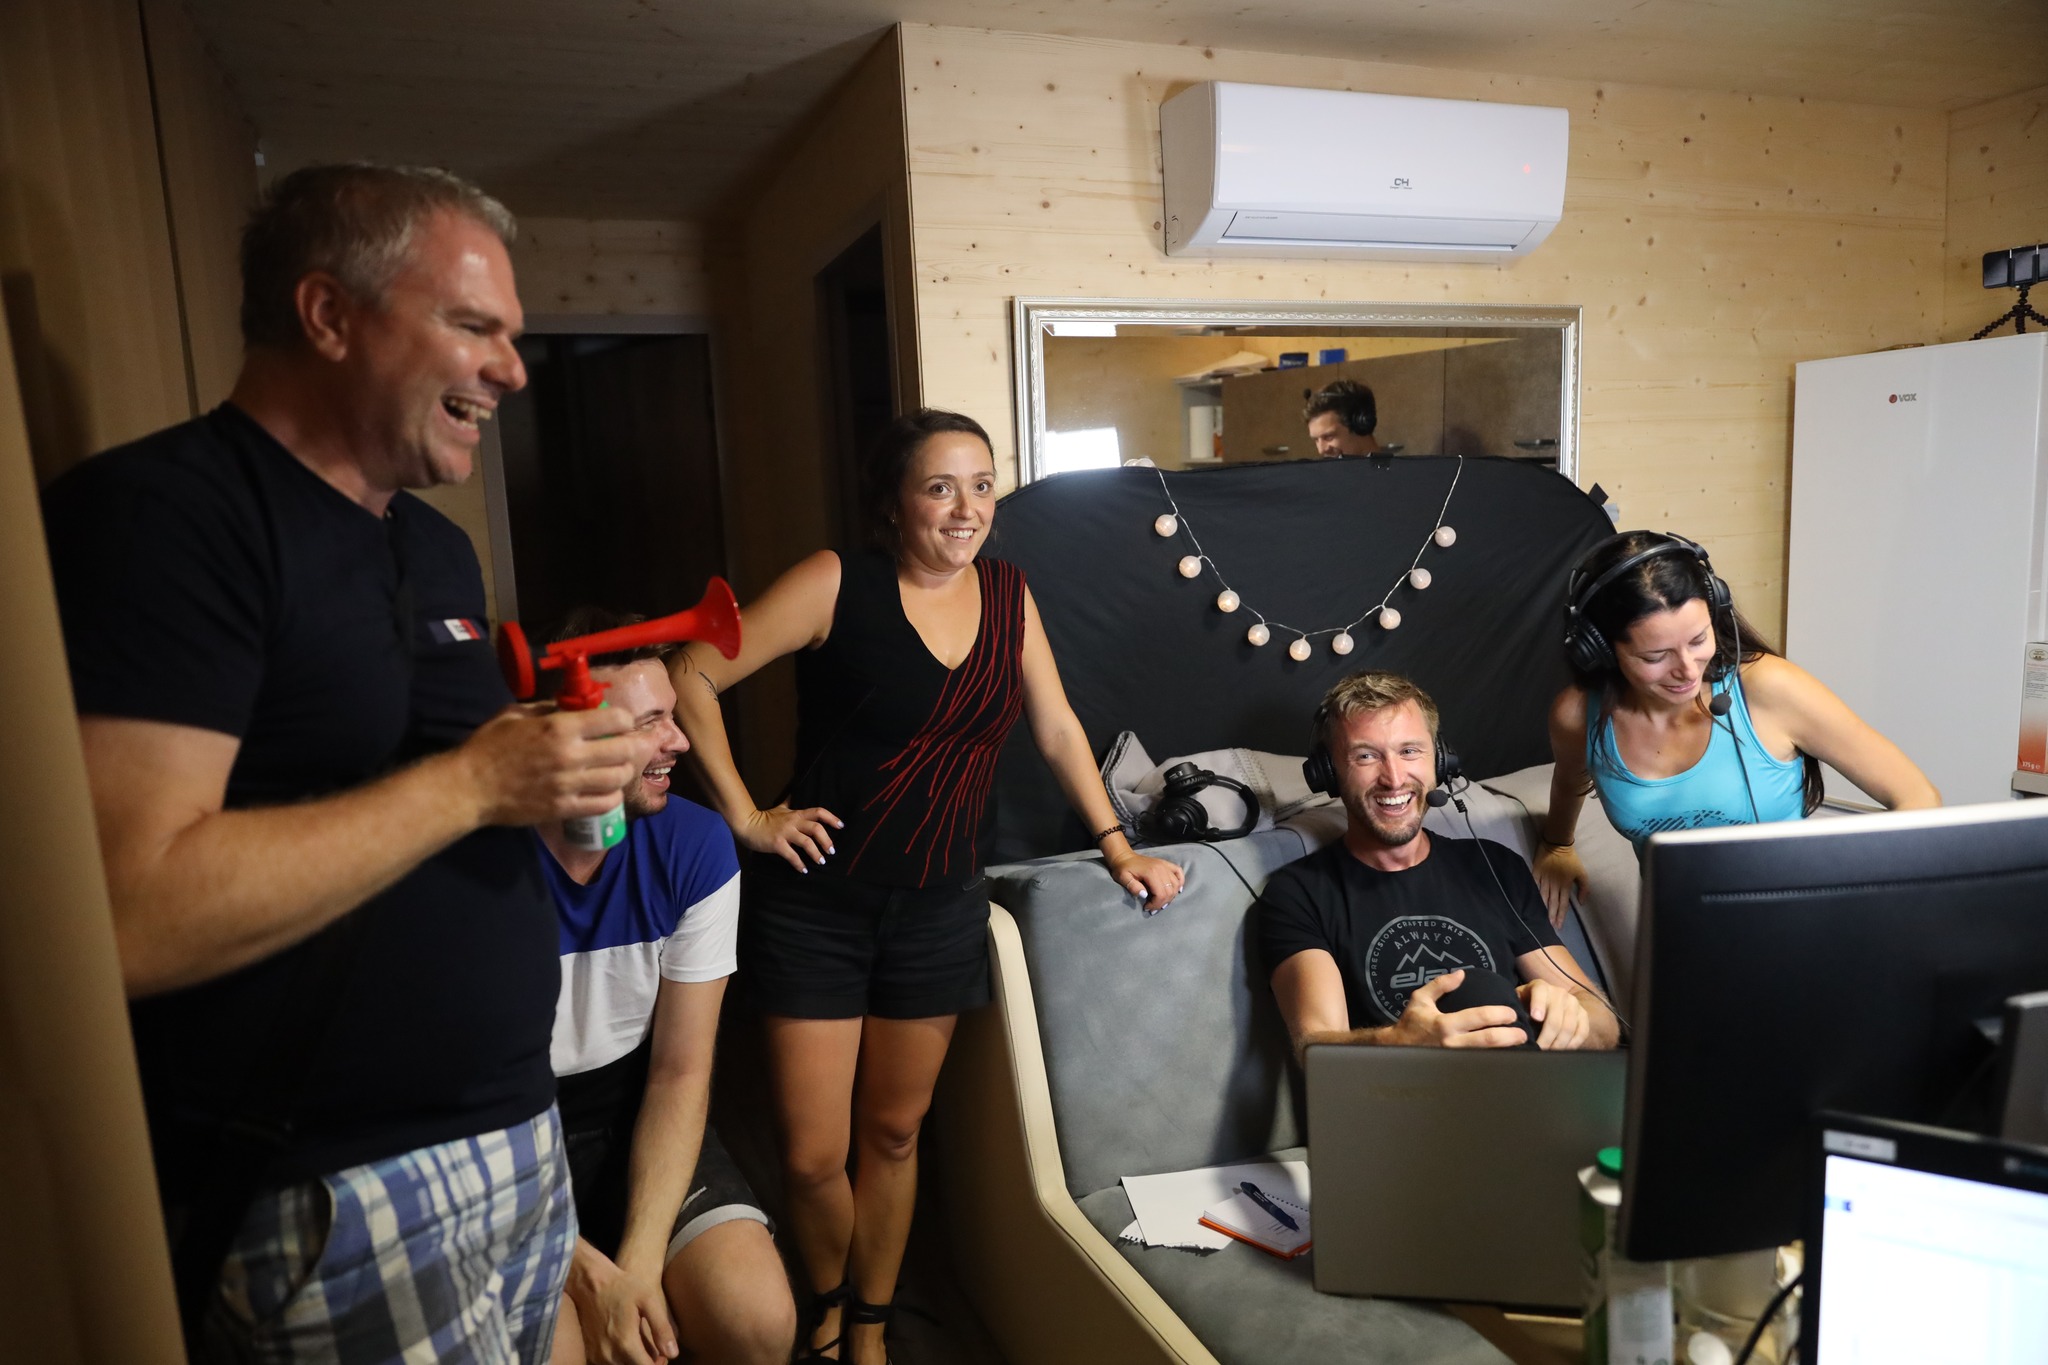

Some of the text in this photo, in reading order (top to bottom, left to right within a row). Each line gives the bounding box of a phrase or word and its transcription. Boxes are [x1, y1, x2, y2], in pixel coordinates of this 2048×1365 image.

[1898, 393, 1917, 402] VOX
[1371, 920, 1489, 977] PRECISION CRAFTED SKIS HAND
[1394, 931, 1452, 950] ALWAYS
[1390, 965, 1475, 989] ela
